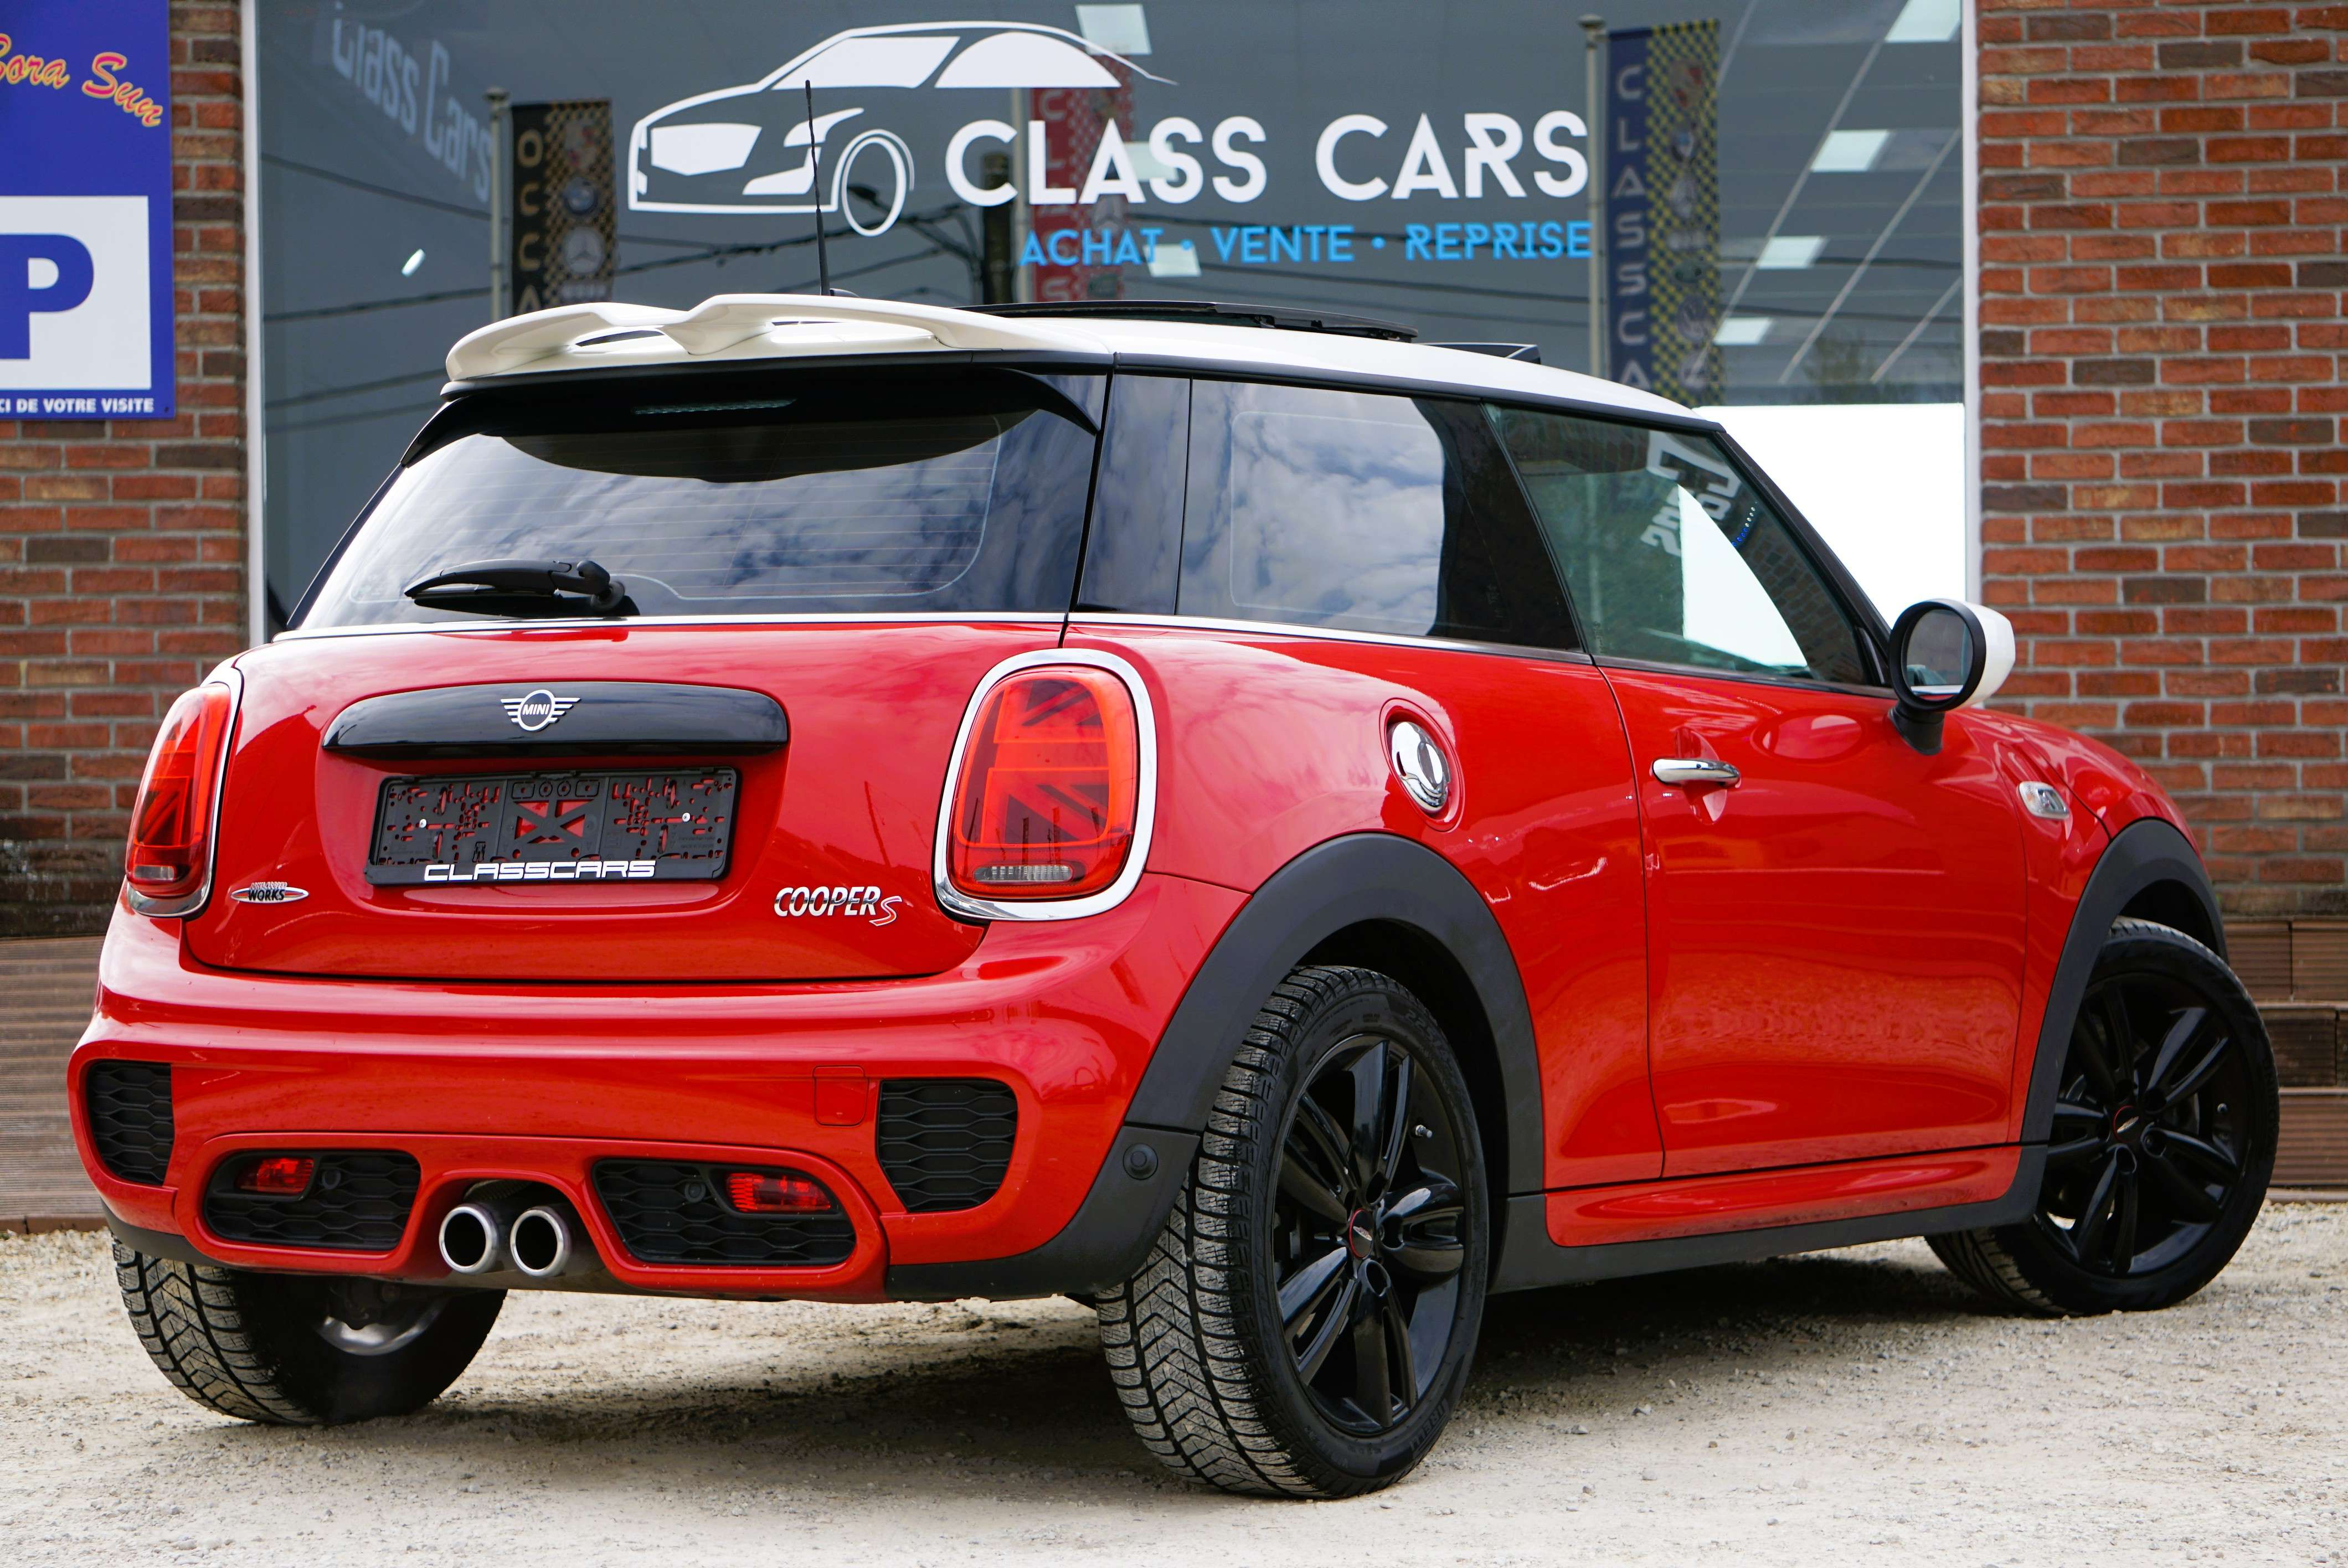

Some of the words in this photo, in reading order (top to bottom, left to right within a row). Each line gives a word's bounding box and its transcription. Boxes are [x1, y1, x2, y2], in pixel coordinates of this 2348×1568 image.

[81, 51, 163, 127] Sun
[946, 118, 1266, 205] CLASS
[1316, 111, 1588, 200] CARS
[1018, 228, 1165, 266] ACHAT
[1209, 224, 1356, 265] VENTE
[1404, 220, 1593, 261] REPRISE
[16, 398, 38, 413] DE
[43, 398, 96, 413] VOTRE
[101, 398, 154, 413] VISITE
[522, 704, 550, 715] MINI
[424, 860, 657, 881] CLASSCARS
[248, 889, 285, 901] WORKS
[774, 886, 882, 917] COOPER
[869, 895, 903, 927] S
